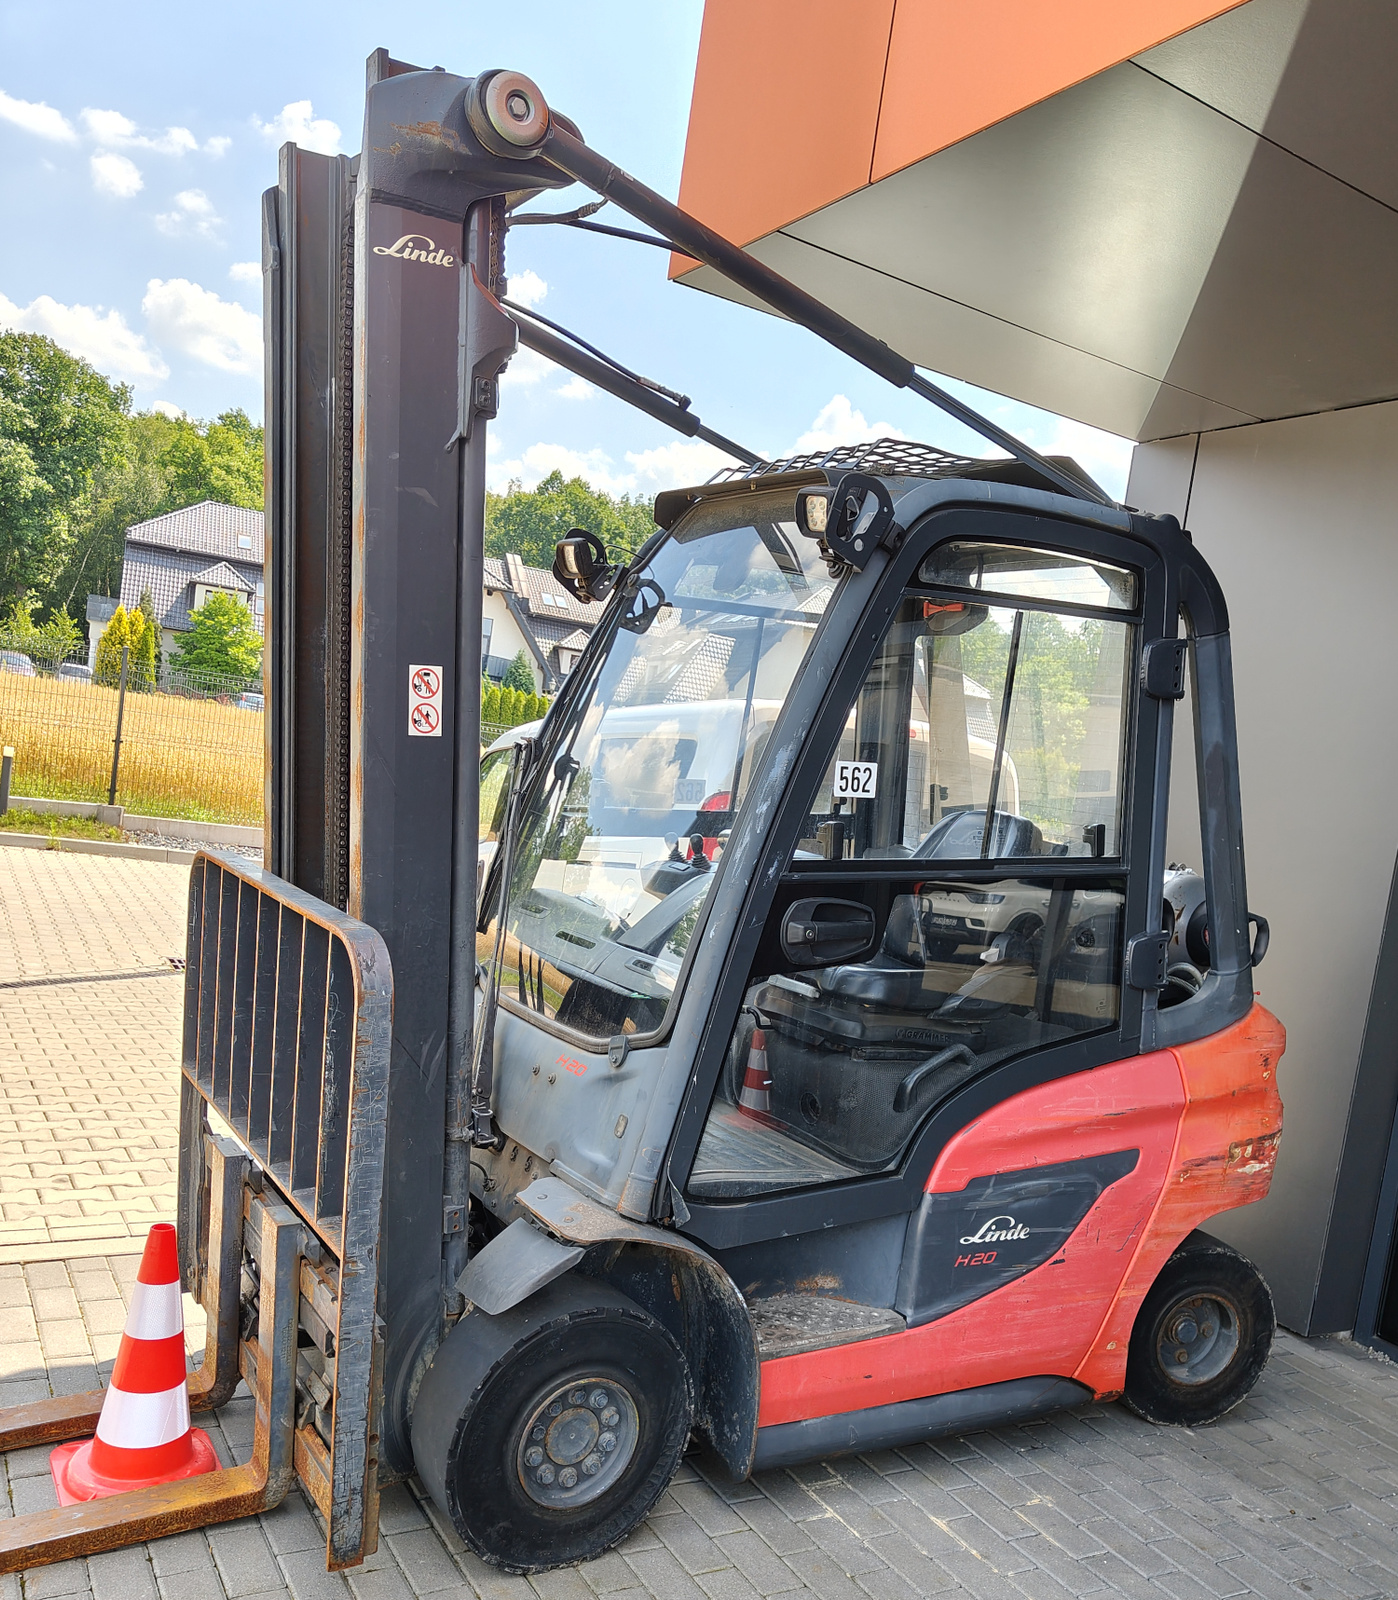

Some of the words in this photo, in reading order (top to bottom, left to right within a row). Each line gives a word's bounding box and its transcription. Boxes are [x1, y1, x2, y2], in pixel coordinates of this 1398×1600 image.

[372, 234, 454, 268] Linde
[839, 766, 872, 793] 562
[555, 1053, 588, 1077] H20
[959, 1215, 1030, 1245] Linde
[954, 1251, 998, 1268] H20
